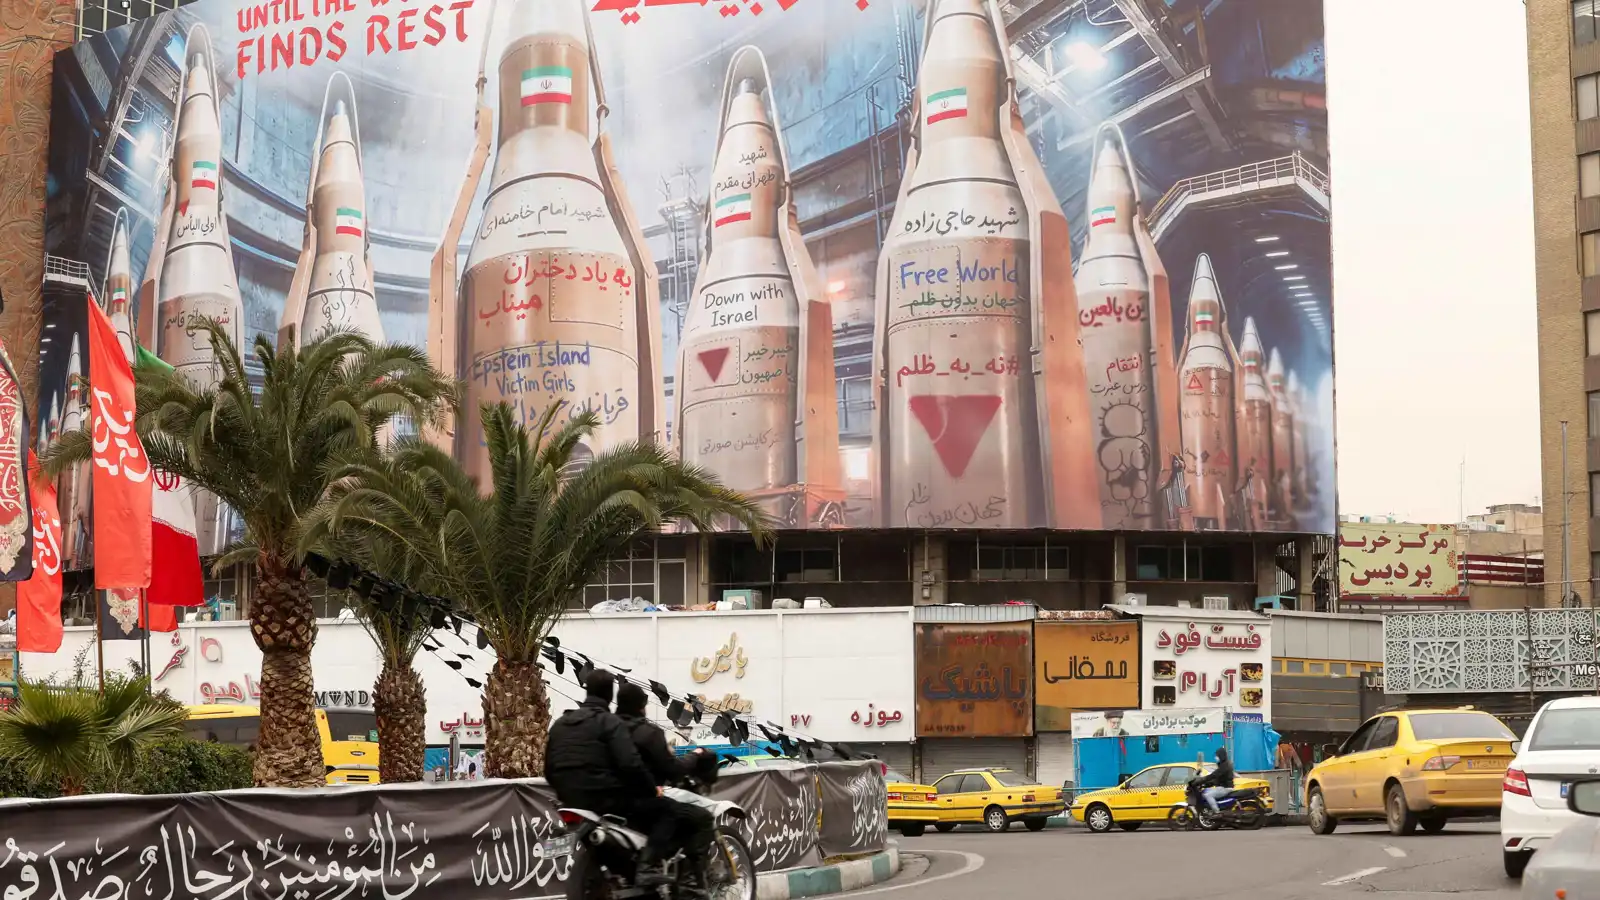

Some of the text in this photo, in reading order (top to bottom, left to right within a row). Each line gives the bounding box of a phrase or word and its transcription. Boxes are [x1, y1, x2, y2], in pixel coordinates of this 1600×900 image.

[236, 0, 304, 33] UNTIL
[236, 0, 475, 80] FINDS REST
[714, 176, 740, 199] مقدم
[537, 202, 568, 225] امام
[977, 206, 1020, 234] شهید
[503, 256, 633, 297] به یاد دختران
[898, 258, 1019, 290] Free World
[703, 282, 784, 310] Down with
[710, 304, 758, 328] Israel
[472, 340, 591, 388] Epstein Island
[1106, 351, 1144, 383] انتقام
[495, 370, 576, 397] Victim Girls
[1090, 382, 1121, 397] عبرت
[1339, 529, 1449, 555] مرکز خرید
[1349, 561, 1434, 589] پردیس
[1091, 630, 1130, 645] فروشگاه
[1156, 622, 1262, 655] فست فود
[1043, 655, 1128, 684] ممقانی
[1180, 668, 1238, 699] آرام
[790, 703, 903, 727] موزه ۲۷
[1142, 715, 1207, 730] موکب برادران
